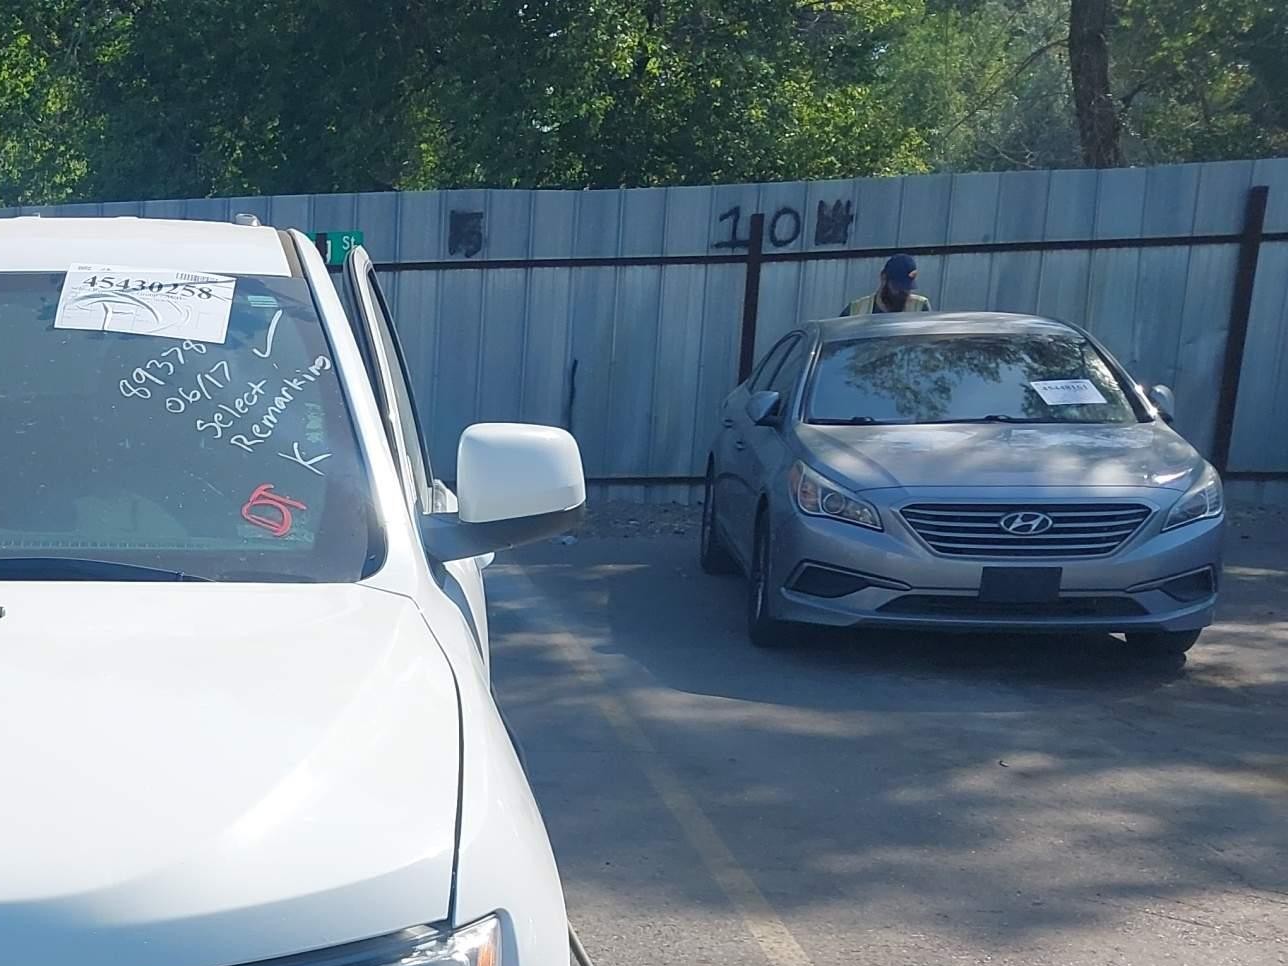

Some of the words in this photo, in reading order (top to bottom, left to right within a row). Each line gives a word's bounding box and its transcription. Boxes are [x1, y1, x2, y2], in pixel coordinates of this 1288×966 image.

[713, 205, 801, 249] 10
[82, 275, 213, 300] 45430258
[119, 339, 207, 399] 89378
[166, 360, 230, 413] 06/17
[197, 380, 266, 438] Select
[278, 442, 332, 476] K
